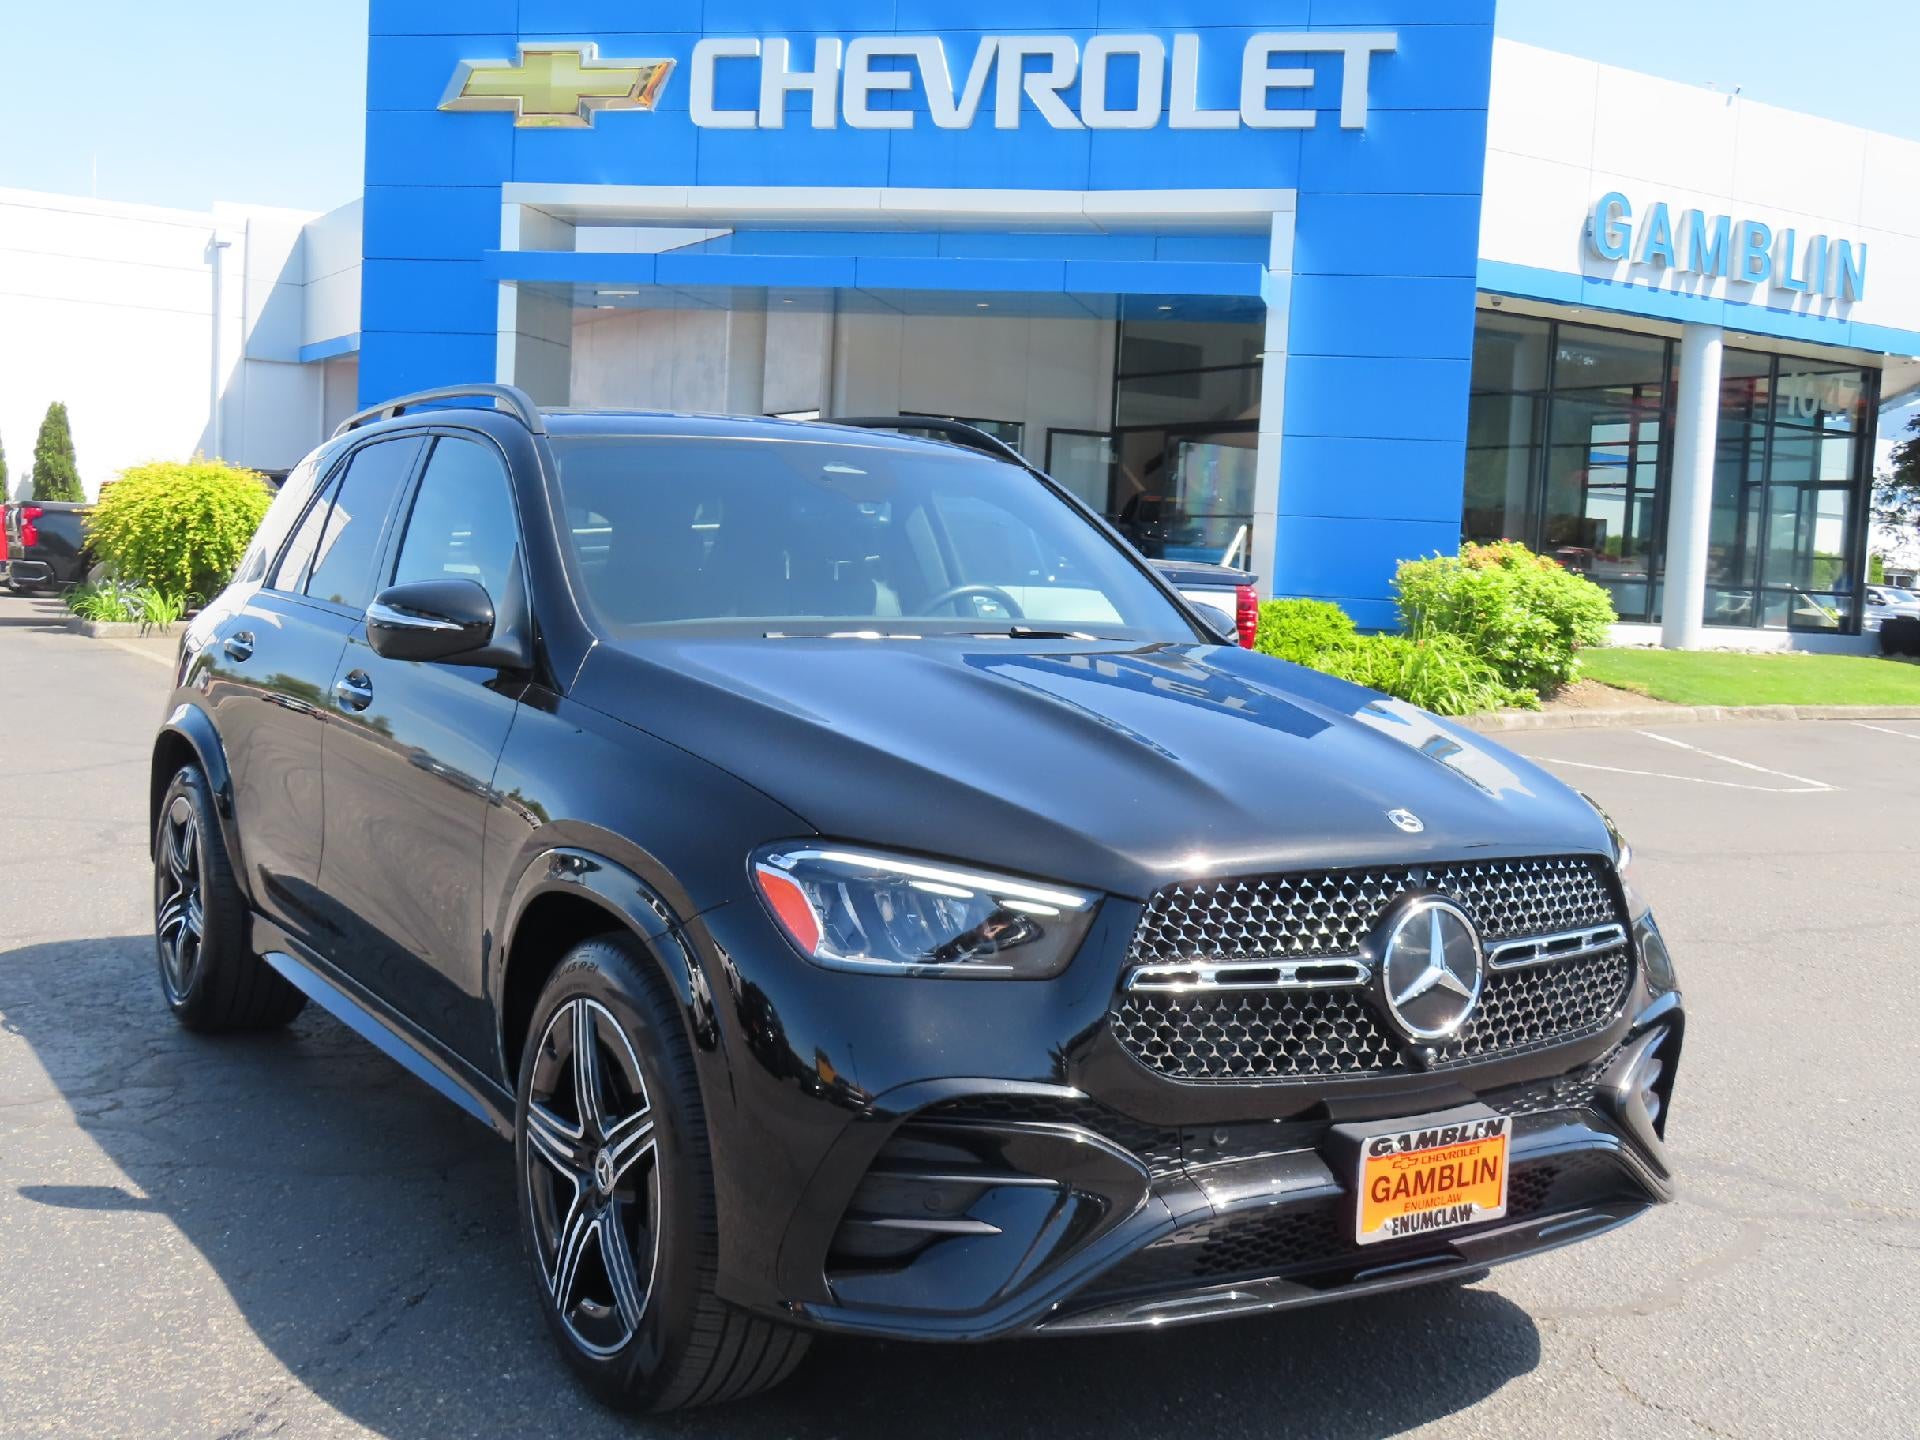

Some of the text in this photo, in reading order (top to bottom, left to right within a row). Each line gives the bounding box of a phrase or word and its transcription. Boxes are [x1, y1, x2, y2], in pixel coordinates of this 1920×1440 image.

[689, 32, 1398, 129] CHEVROLET
[1592, 191, 1867, 302] GAMBLIN
[1369, 1119, 1504, 1156] GAMBLIN
[1421, 1146, 1481, 1165] CHEVROLET
[1372, 1157, 1497, 1203] GAMBLIN
[1391, 1203, 1473, 1235] ENUMCLAW
[1403, 1193, 1463, 1212] ENUMCLAW
